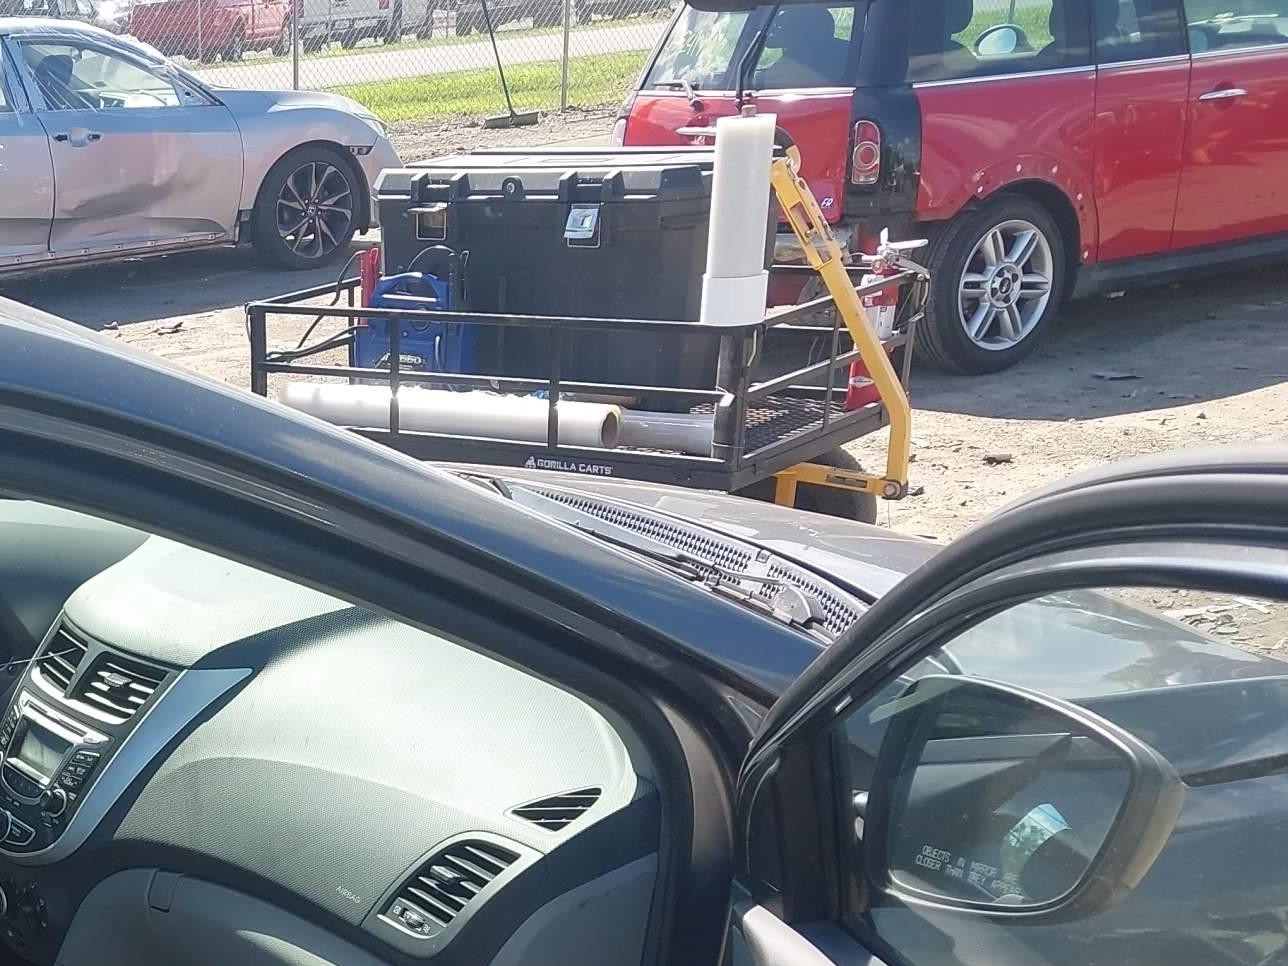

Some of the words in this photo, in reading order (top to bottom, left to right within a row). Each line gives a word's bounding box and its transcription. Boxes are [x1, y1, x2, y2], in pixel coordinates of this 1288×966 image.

[537, 458, 577, 472] GORILLA
[579, 463, 613, 475] CARTS
[922, 845, 951, 863] OBJECTS
[915, 854, 942, 871] CLOSER
[945, 864, 964, 879] THAN
[968, 871, 987, 886] THEY
[336, 886, 361, 904] AIRBAG
